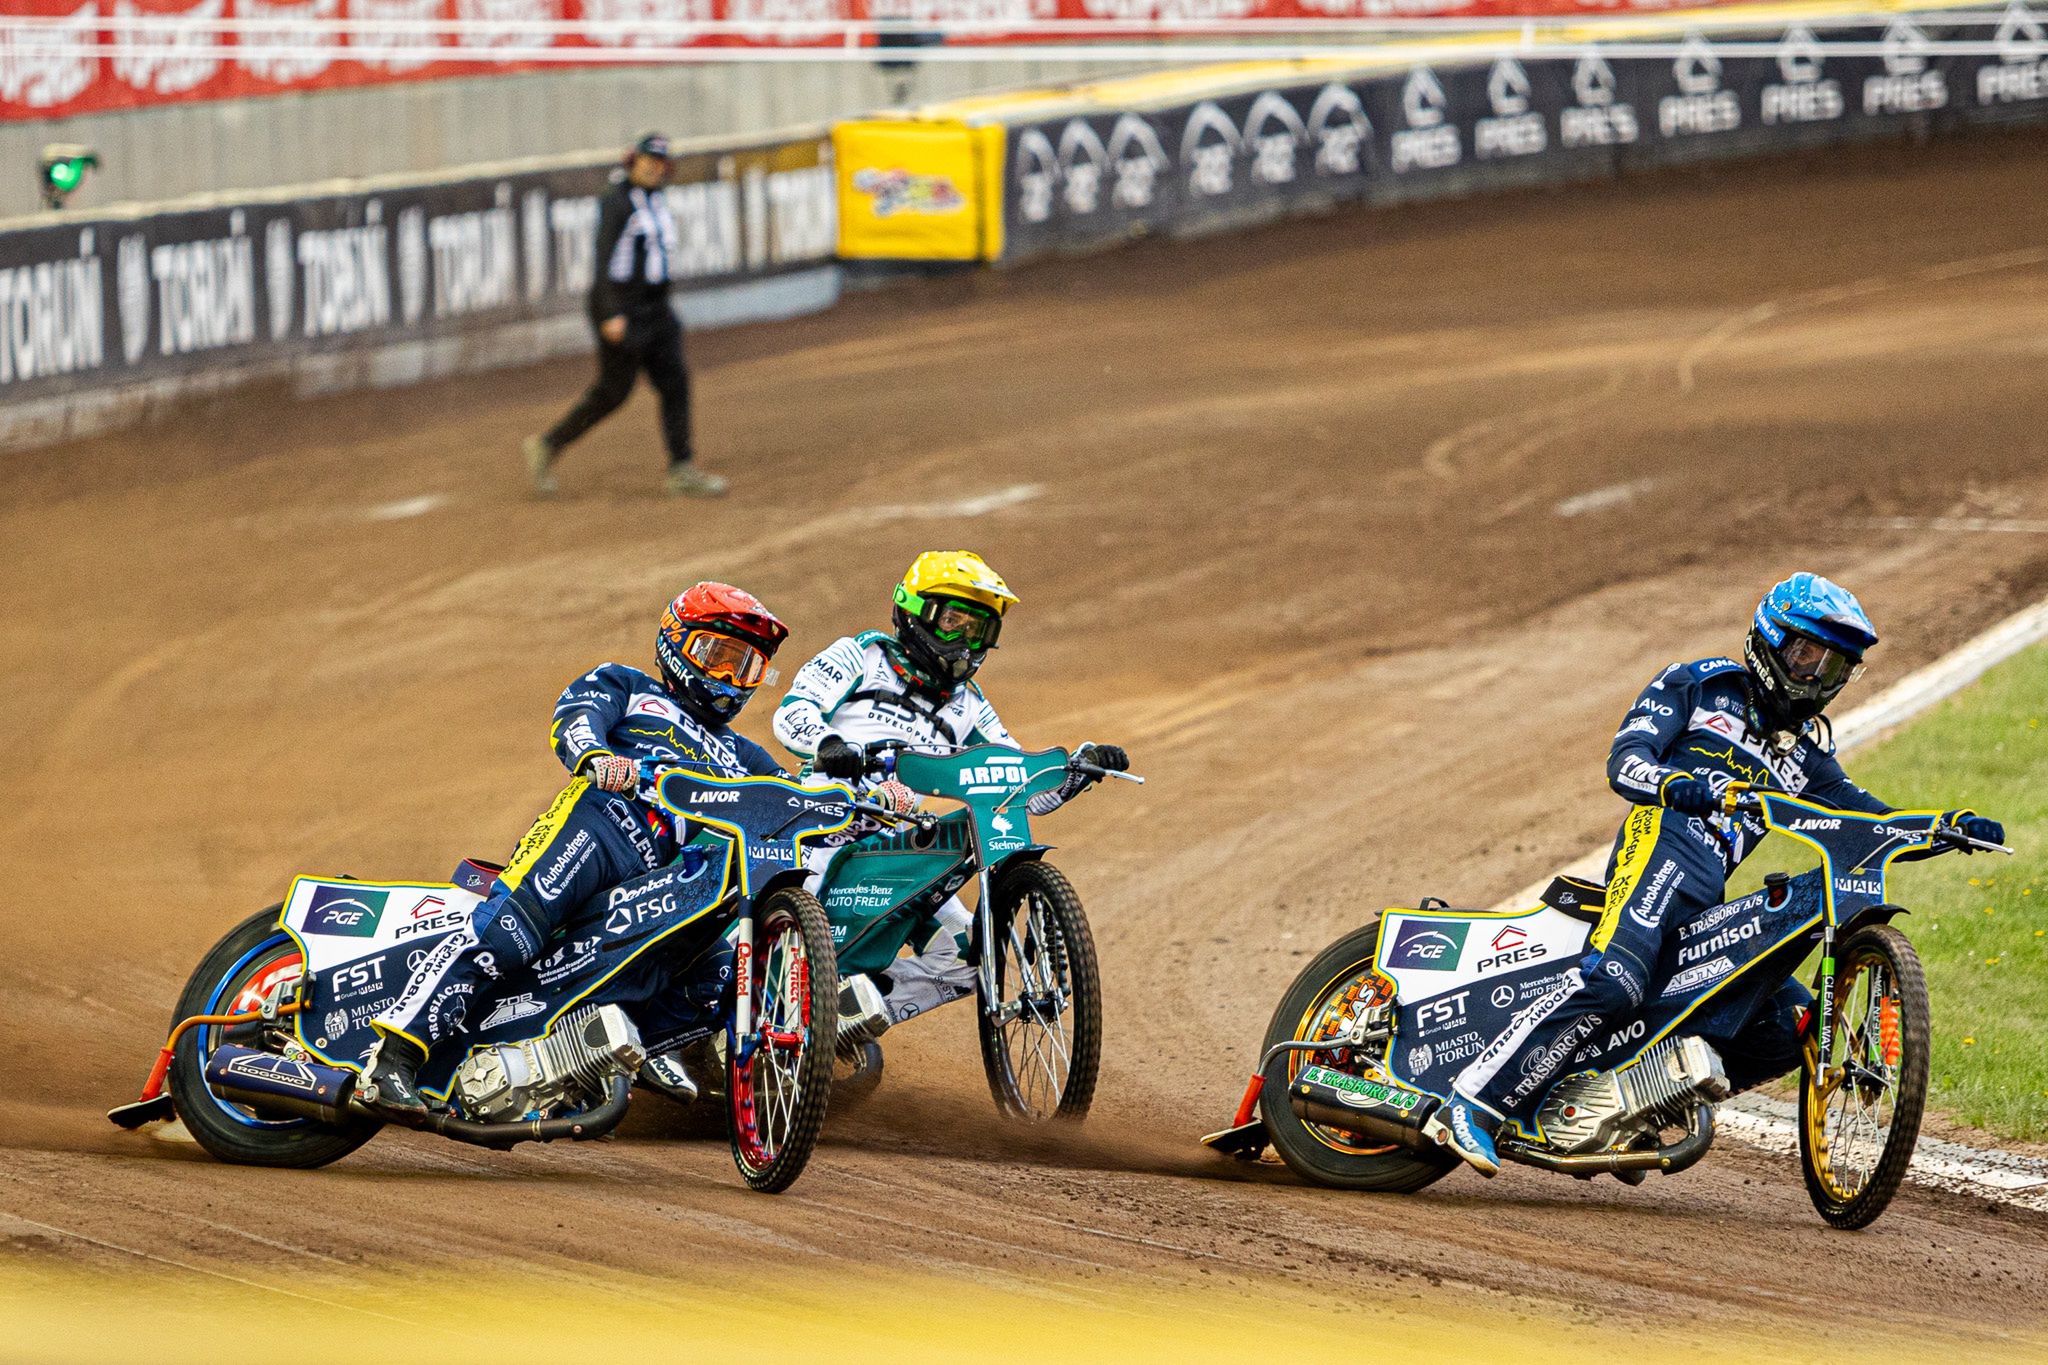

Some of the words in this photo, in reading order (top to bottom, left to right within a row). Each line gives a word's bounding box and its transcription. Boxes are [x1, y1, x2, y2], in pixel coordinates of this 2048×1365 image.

[1638, 697, 1674, 717] AVO
[690, 791, 740, 803] LAVOR
[1788, 818, 1842, 831] LAVOR
[540, 829, 589, 889] AutoAndreas
[750, 846, 794, 860] MAK
[828, 885, 893, 895] Mercedes-Benz
[1638, 859, 1677, 919] AutoAndreas
[1834, 877, 1881, 895] MAK
[636, 894, 677, 923] FSG
[825, 897, 853, 907] AUTO
[854, 896, 891, 907] FRELIK
[322, 910, 364, 926] PGE
[395, 911, 465, 939] PRES
[1679, 926, 1690, 941] E.
[1691, 904, 1740, 935] TRASBORG
[1743, 895, 1764, 910] A/S
[1406, 944, 1446, 959] PGE
[1477, 943, 1547, 973] PRES
[332, 955, 386, 994] FST
[736, 942, 752, 997] Pentel
[495, 992, 533, 1009] ZDB
[1520, 987, 1544, 1000] AUTO
[1823, 975, 1835, 1016] CLEAN
[350, 996, 396, 1018] MIASTO
[1416, 990, 1470, 1029] FST
[1434, 1031, 1478, 1053] MIASTO
[1607, 1020, 1646, 1051] AVO
[1821, 1026, 1832, 1052] WAY
[1515, 1034, 1578, 1096] TRASBORG
[1579, 1014, 1602, 1038] A/S
[236, 1065, 306, 1087] ROGOWO
[1322, 1071, 1390, 1101] TRASBORG
[1390, 1094, 1418, 1109] A/S
